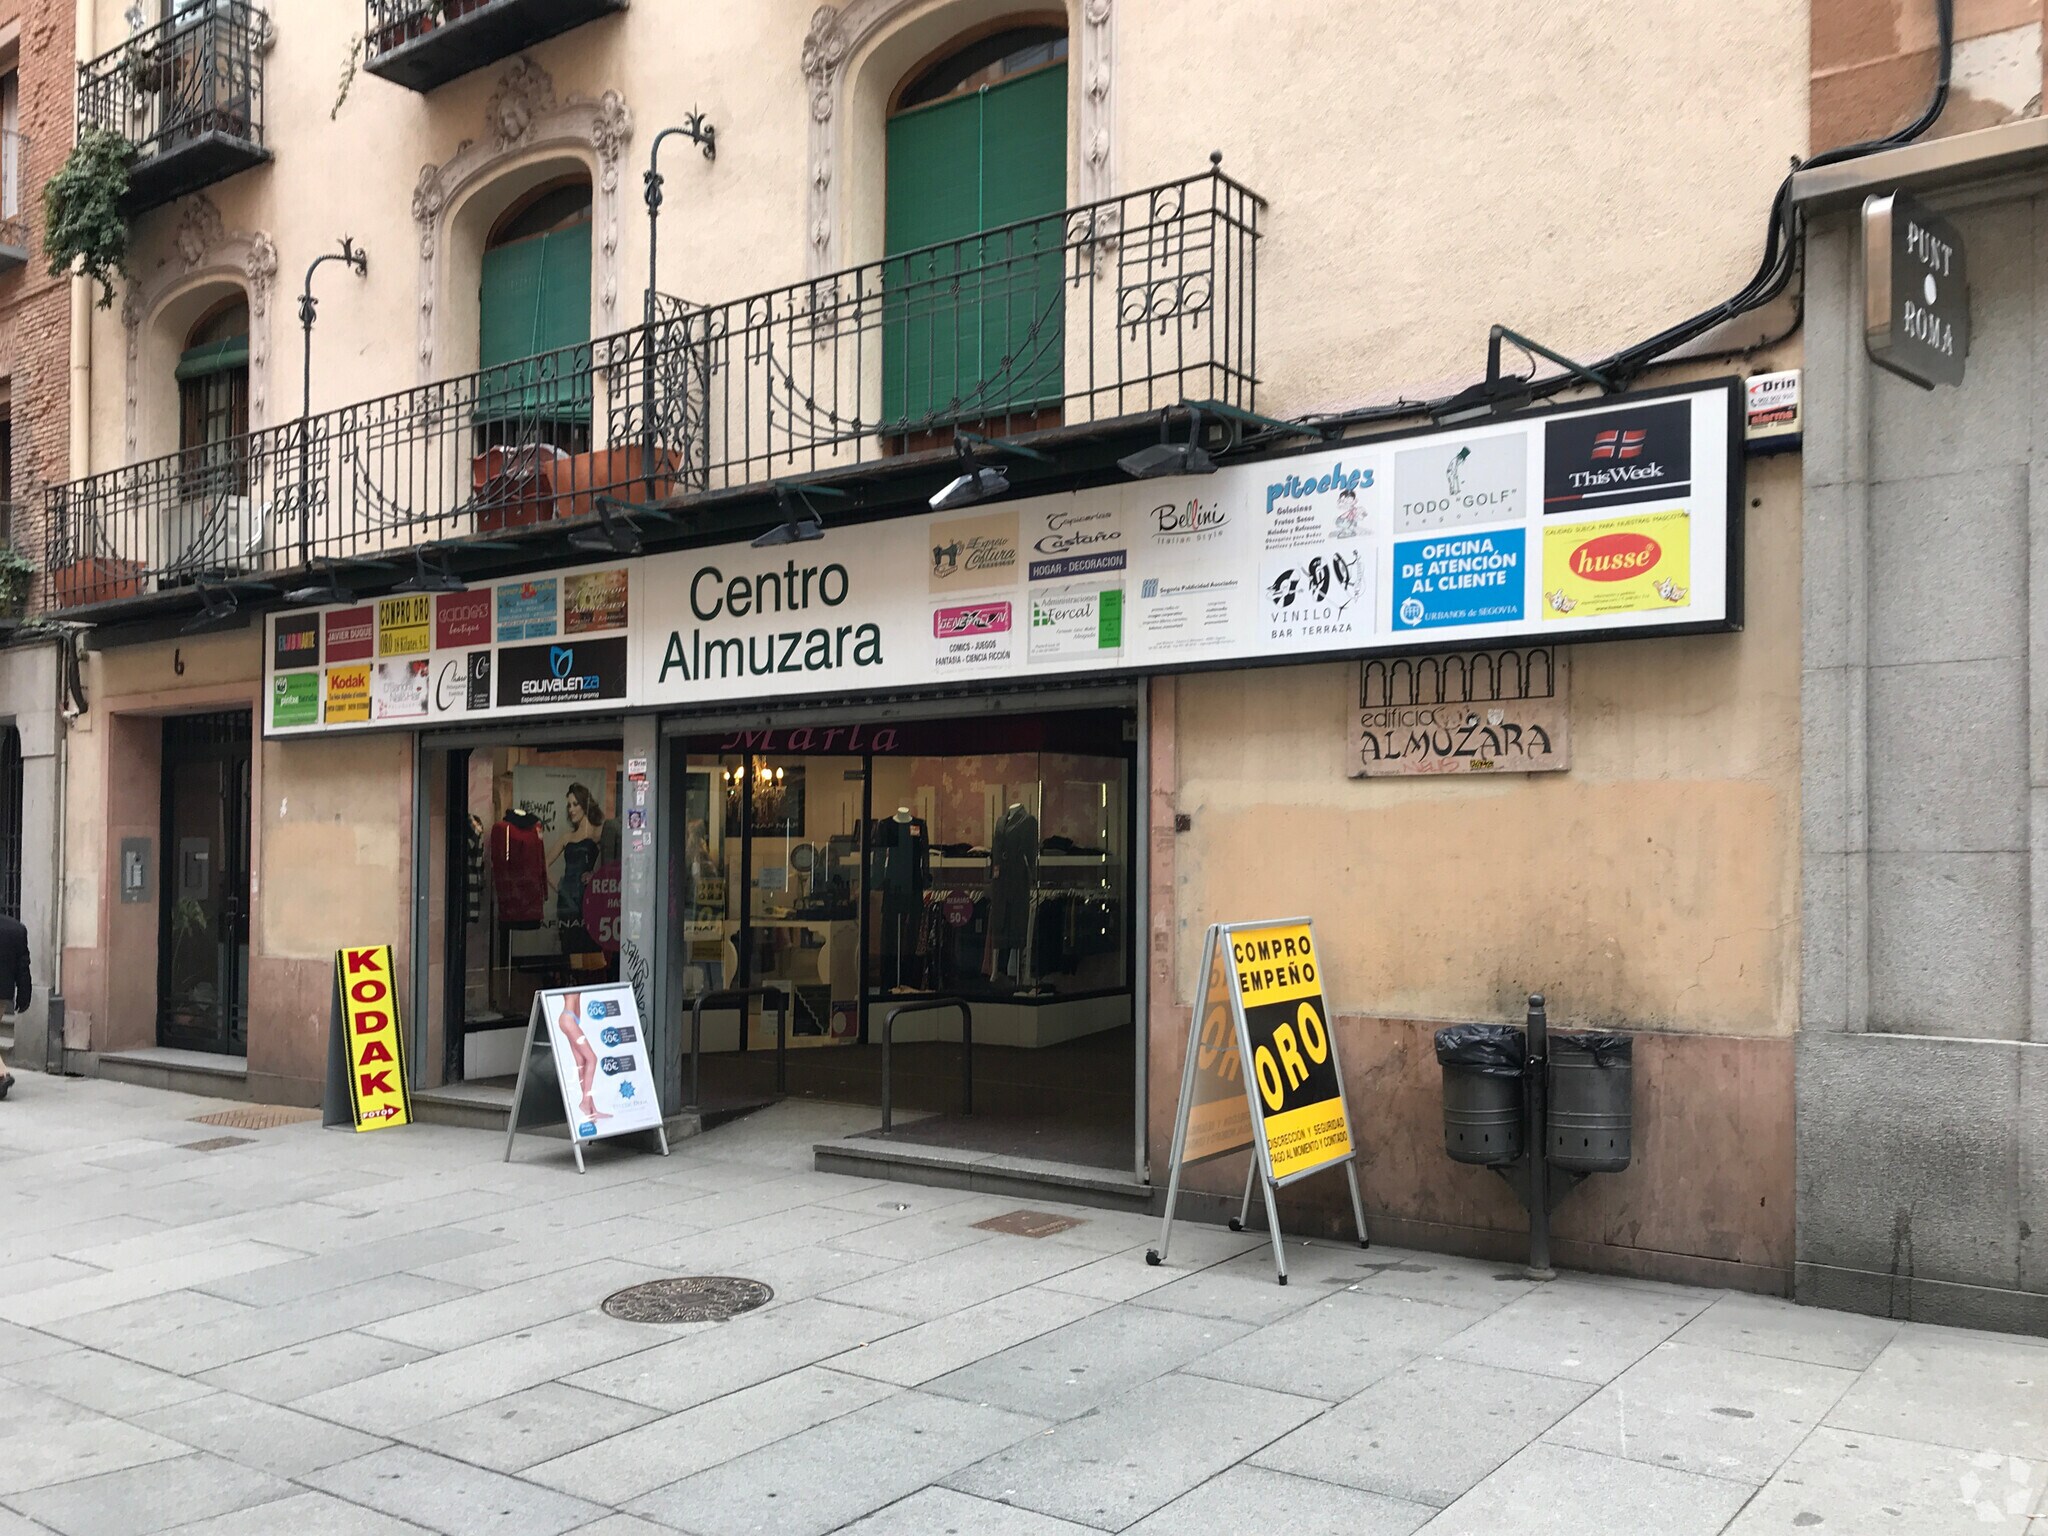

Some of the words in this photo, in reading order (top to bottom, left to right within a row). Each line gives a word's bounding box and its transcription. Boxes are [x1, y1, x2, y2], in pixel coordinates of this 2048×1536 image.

[1908, 221, 1952, 277] PUNT
[1904, 300, 1953, 356] ROMA
[1150, 498, 1225, 532] Bellini
[1403, 499, 1450, 516] TODO
[1033, 530, 1122, 554] Castaño
[1422, 538, 1494, 559] OFICINA
[1032, 563, 1063, 577] HOGAR
[1402, 563, 1424, 579] DE
[1427, 550, 1517, 576] ATENCIÓN
[690, 559, 849, 621] Centro
[1411, 579, 1434, 594] AL
[1438, 570, 1507, 591] CLIENTE
[380, 599, 411, 626] COMPRO
[413, 597, 429, 623] ORO
[1045, 603, 1094, 625] Fercal
[1271, 607, 1332, 623] VINILO
[328, 629, 350, 641] JAVIER
[350, 626, 373, 639] DUQUE
[1271, 629, 1293, 639] BAR
[1302, 623, 1353, 636] TERRAZA
[380, 633, 393, 654] ORO
[658, 622, 884, 684] Almuzara
[331, 673, 365, 689] Kodak
[1360, 707, 1435, 728] edificio
[1360, 716, 1553, 765] ALMUZARA
[1234, 935, 1311, 964] COMPRO
[1240, 961, 1315, 993] EMPEÑO
[347, 948, 396, 1097] KODAK
[1254, 1001, 1327, 1112] ORO
[362, 1108, 394, 1119] FOTOS
[1306, 1127, 1312, 1137] Y
[1313, 1116, 1345, 1136] SEGURIDAD
[1286, 1146, 1293, 1160] AL
[1293, 1139, 1319, 1157] MOMENTO
[1319, 1138, 1324, 1149] Y
[1324, 1131, 1348, 1147] CONTADO
